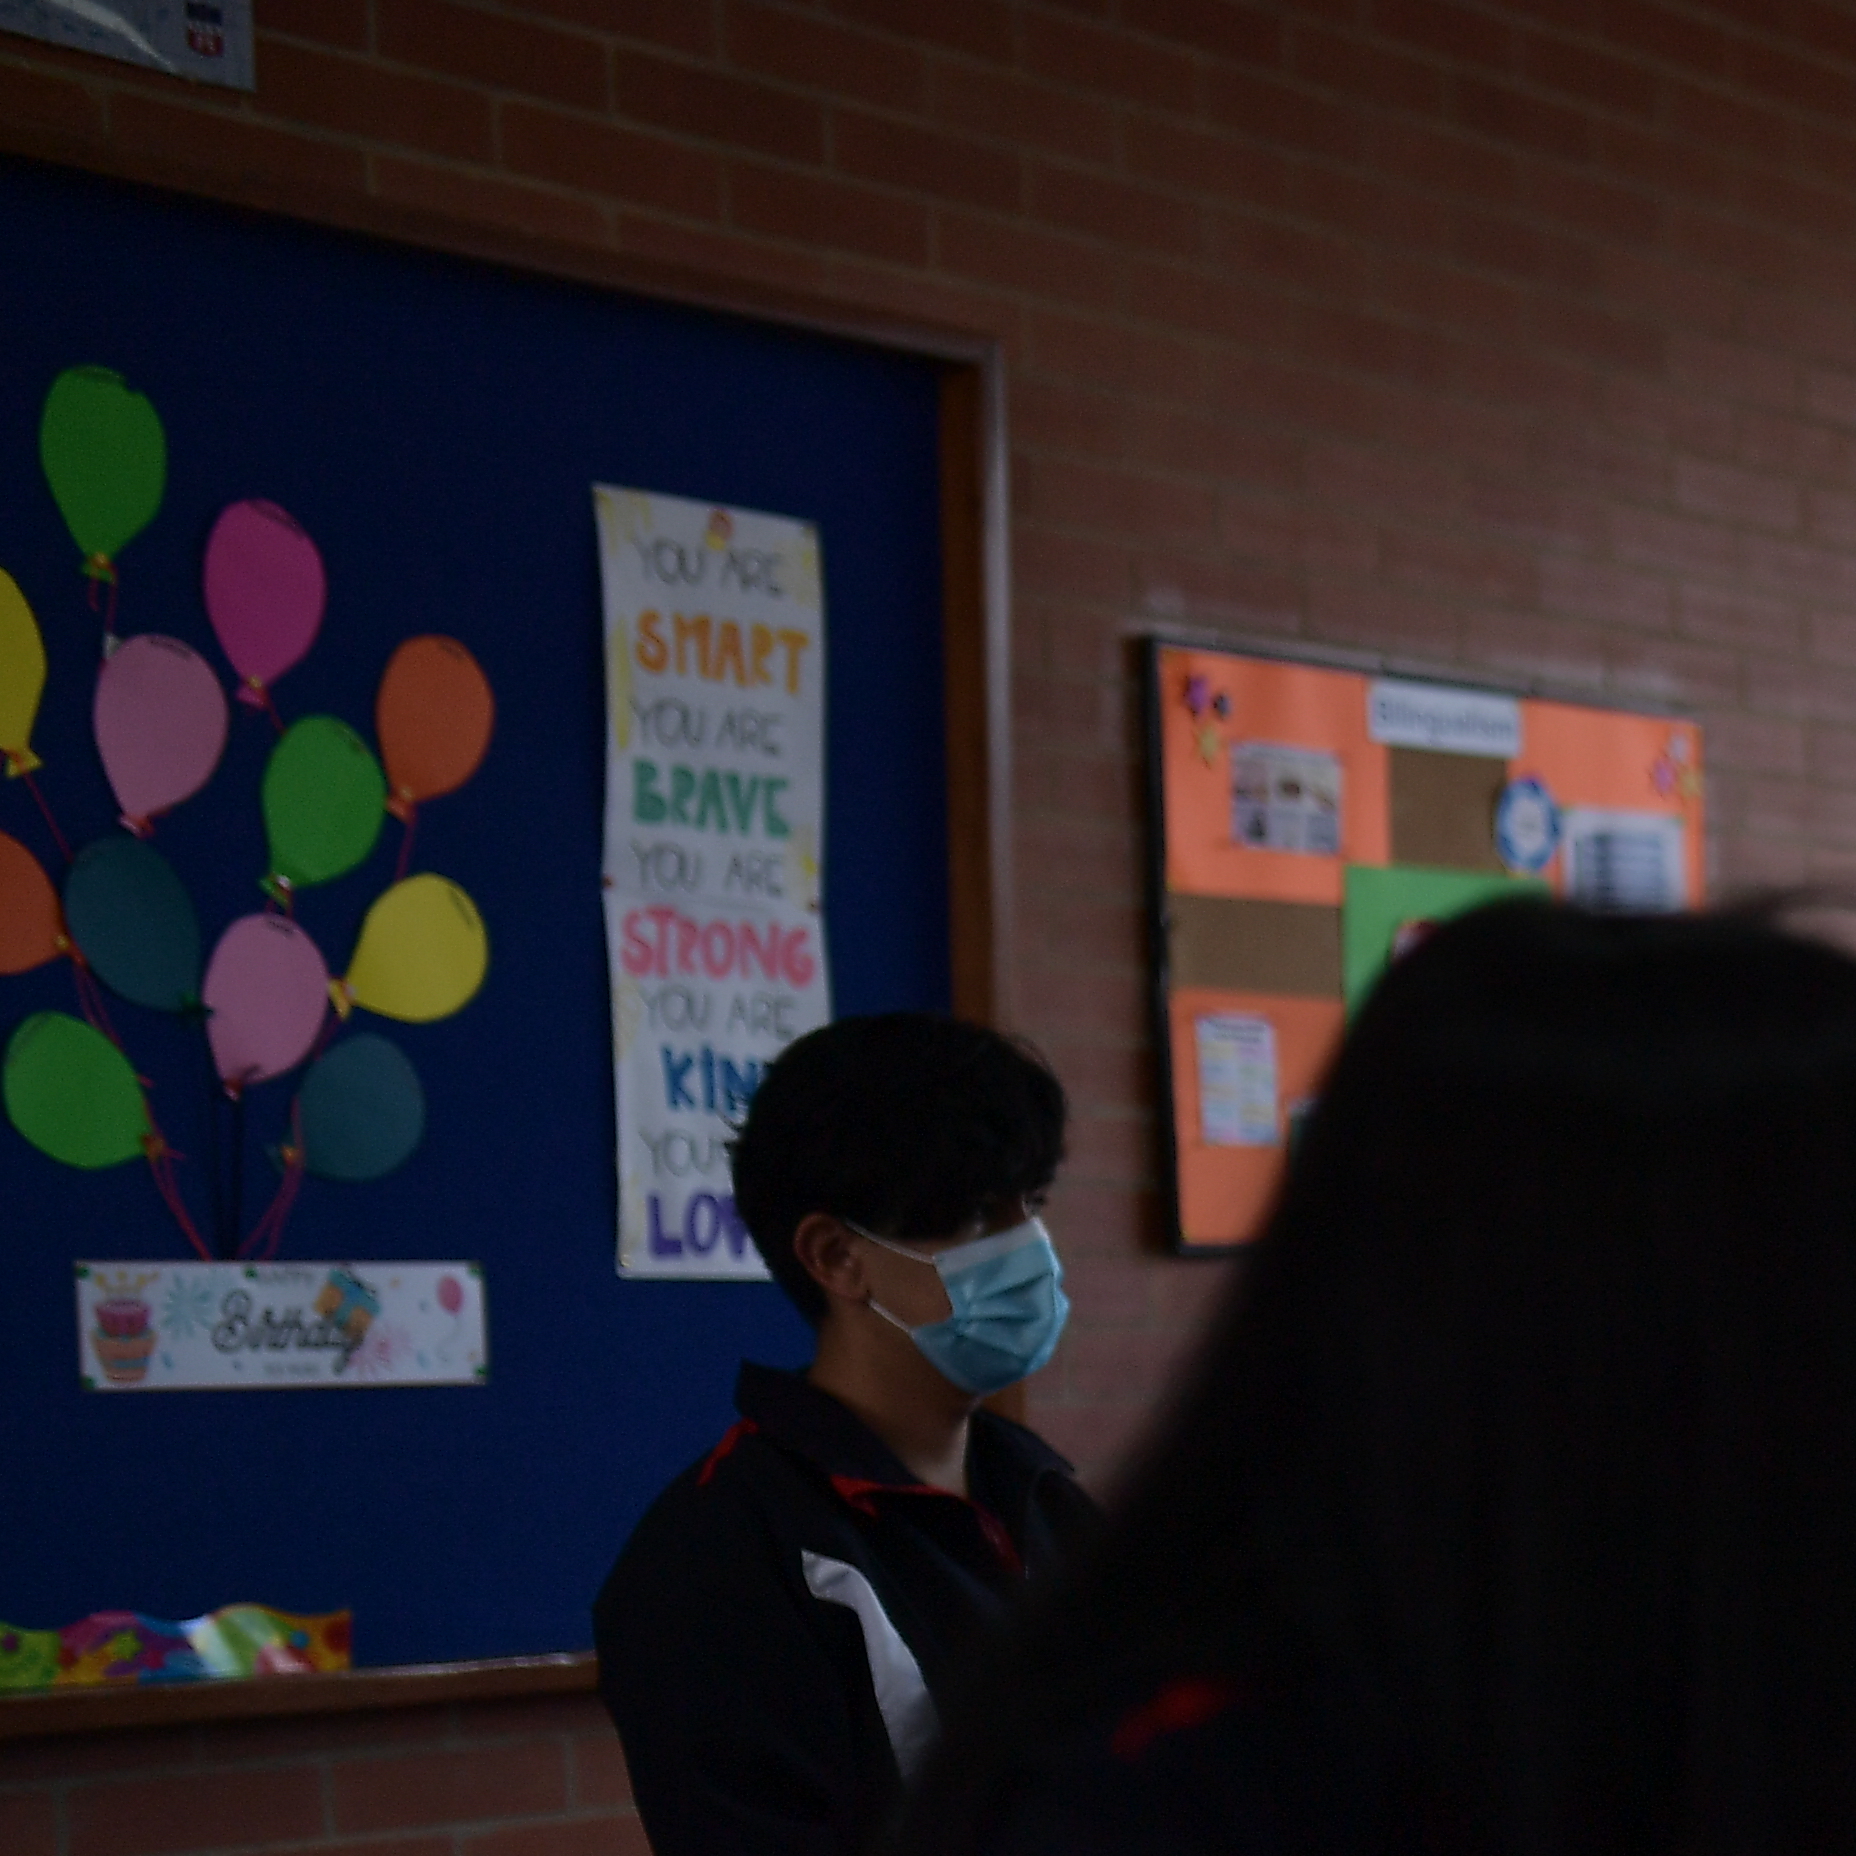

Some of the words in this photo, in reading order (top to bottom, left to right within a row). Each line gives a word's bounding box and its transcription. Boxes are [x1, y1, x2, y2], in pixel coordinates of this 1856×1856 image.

[631, 536, 706, 586] YOU
[634, 608, 810, 695] SMART
[630, 697, 706, 749] YOU
[715, 708, 783, 758] ARE
[632, 757, 791, 838] BRAVE
[630, 841, 704, 893] YOU
[722, 853, 784, 898] ARE
[621, 906, 816, 988] STRONG
[639, 984, 709, 1032] YOU
[724, 992, 797, 1041] ARE
[660, 1042, 771, 1113] KIN
[647, 1190, 752, 1260] LOV
